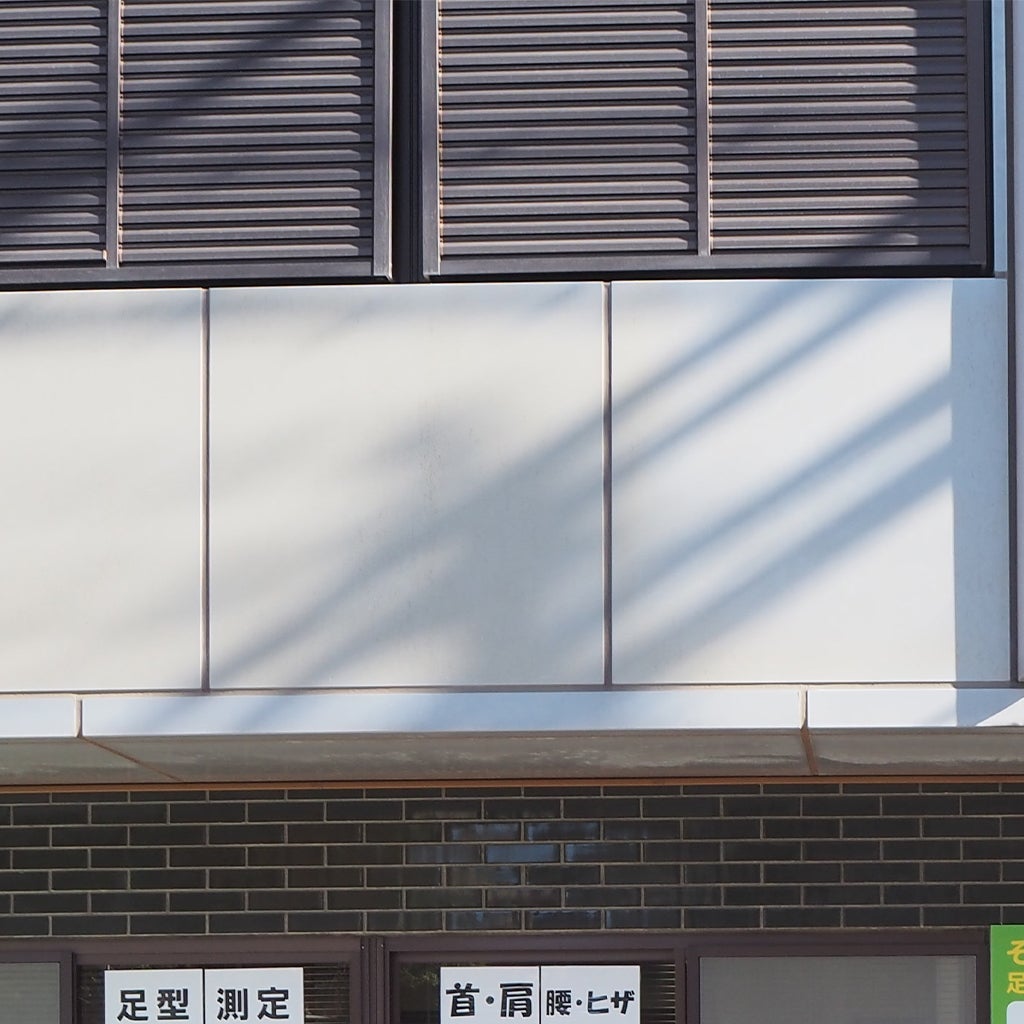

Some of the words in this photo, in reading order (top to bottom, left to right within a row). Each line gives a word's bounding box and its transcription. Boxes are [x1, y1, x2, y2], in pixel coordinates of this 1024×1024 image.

[117, 988, 190, 1021] 足型
[217, 987, 290, 1021] 測定
[446, 983, 534, 1018] 首・肩
[546, 990, 635, 1016] 腰・ヒザ
